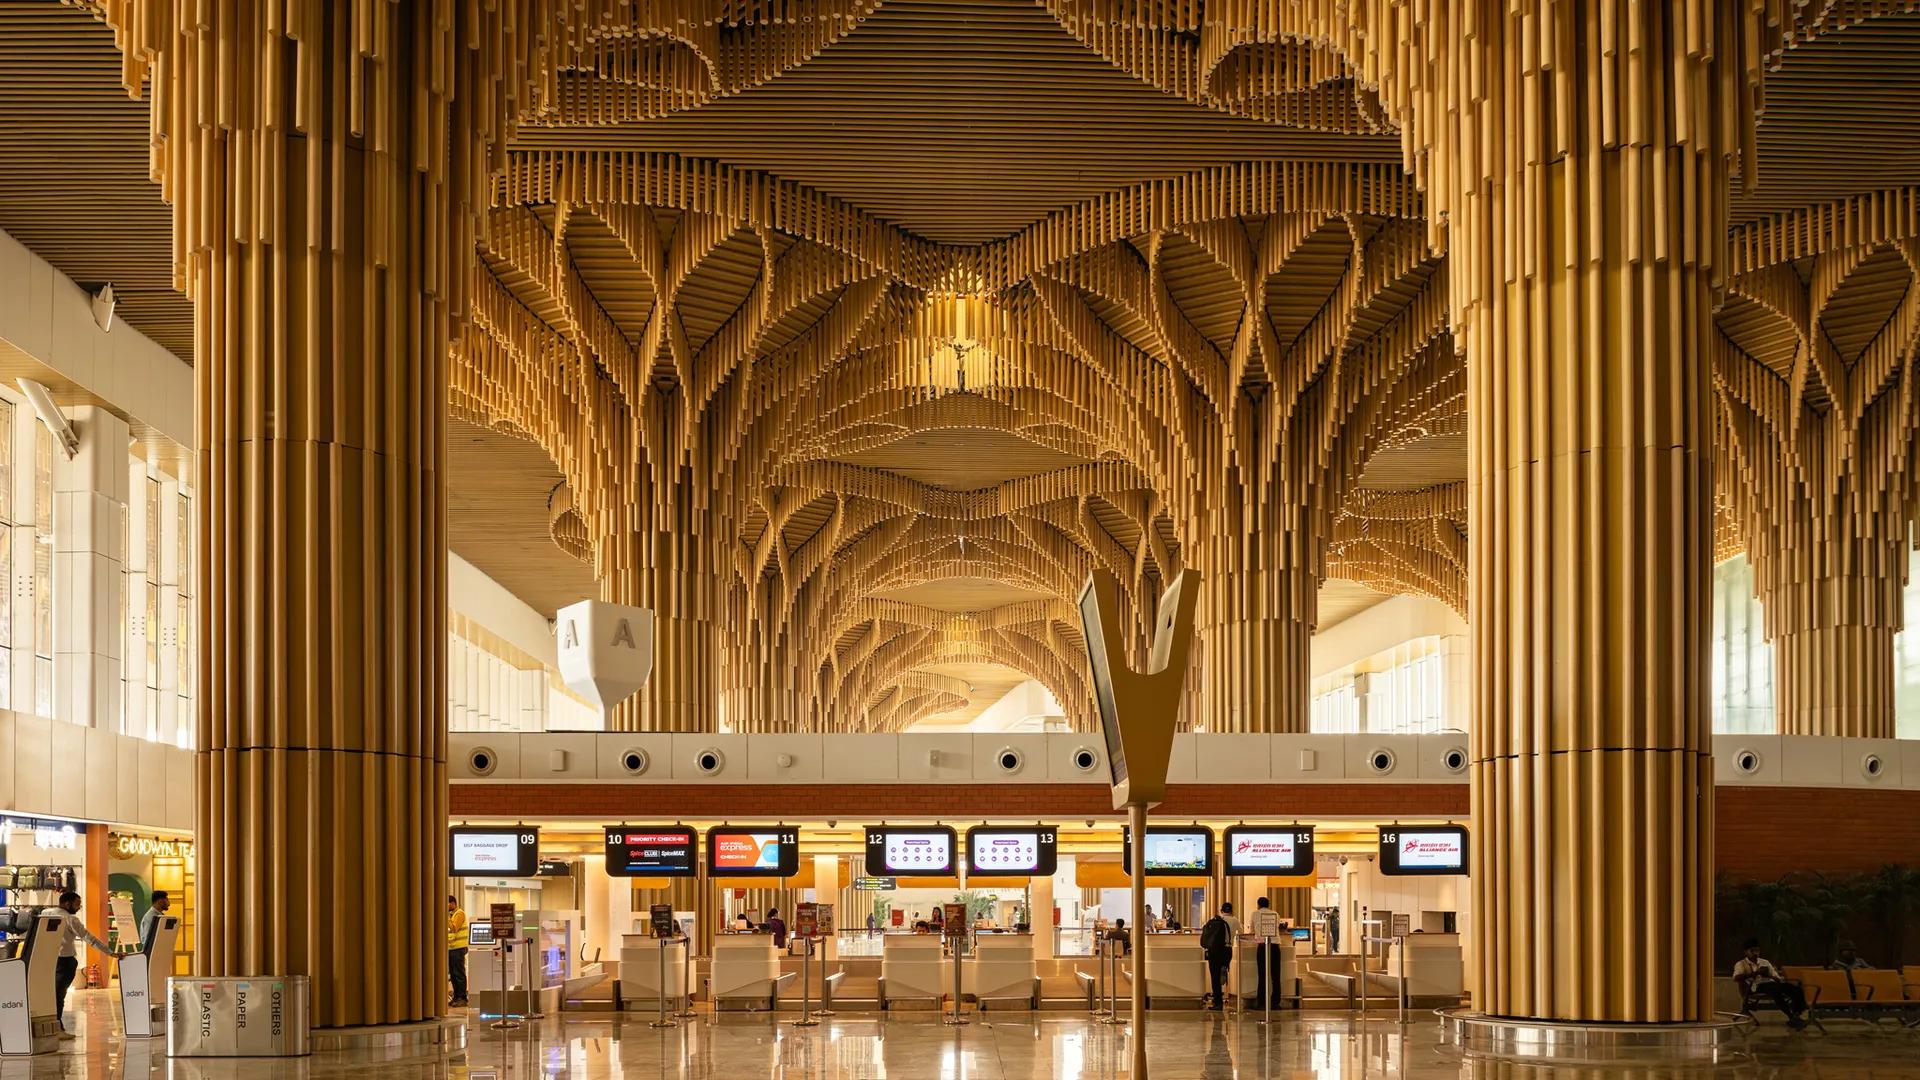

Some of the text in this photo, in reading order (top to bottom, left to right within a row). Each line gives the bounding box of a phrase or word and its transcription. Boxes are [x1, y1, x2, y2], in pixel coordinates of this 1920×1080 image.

[563, 618, 579, 649] A
[610, 617, 636, 649] A
[520, 834, 535, 845] 09
[608, 834, 622, 845] 10
[781, 834, 796, 844] 11
[869, 834, 883, 844] 12
[1040, 833, 1054, 844] 13
[1297, 833, 1310, 844] 15
[1382, 833, 1396, 844] 16
[1, 999, 24, 1009] adani
[202, 992, 211, 1037] PLASTIC
[237, 991, 246, 1029] PAPER
[271, 991, 281, 1036] OTHERS
